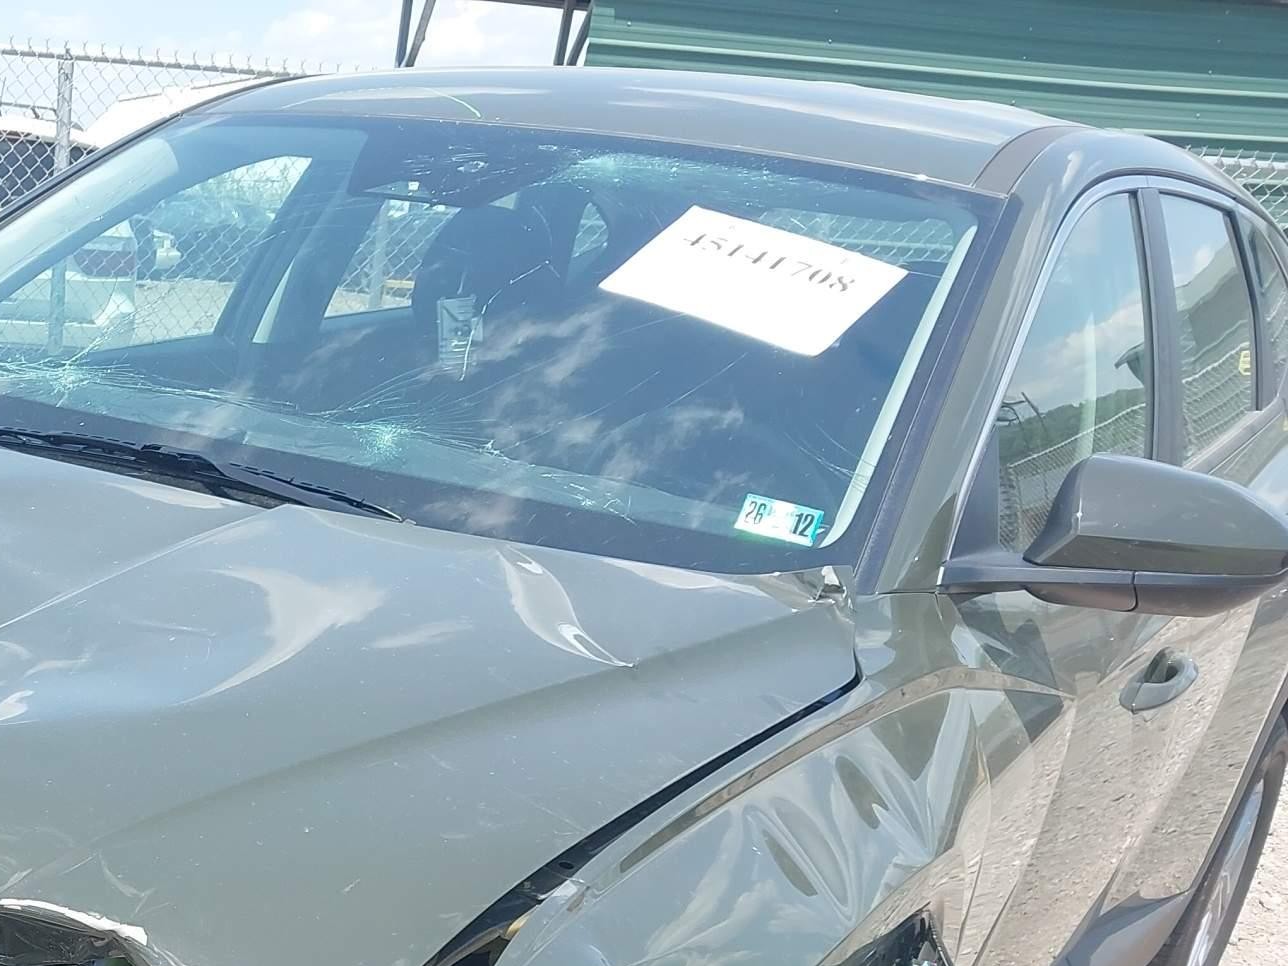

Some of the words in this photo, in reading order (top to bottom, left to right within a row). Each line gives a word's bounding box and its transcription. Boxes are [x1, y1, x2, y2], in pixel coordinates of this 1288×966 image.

[682, 233, 856, 293] 45141708
[744, 500, 767, 525] 26
[792, 512, 815, 537] 12
